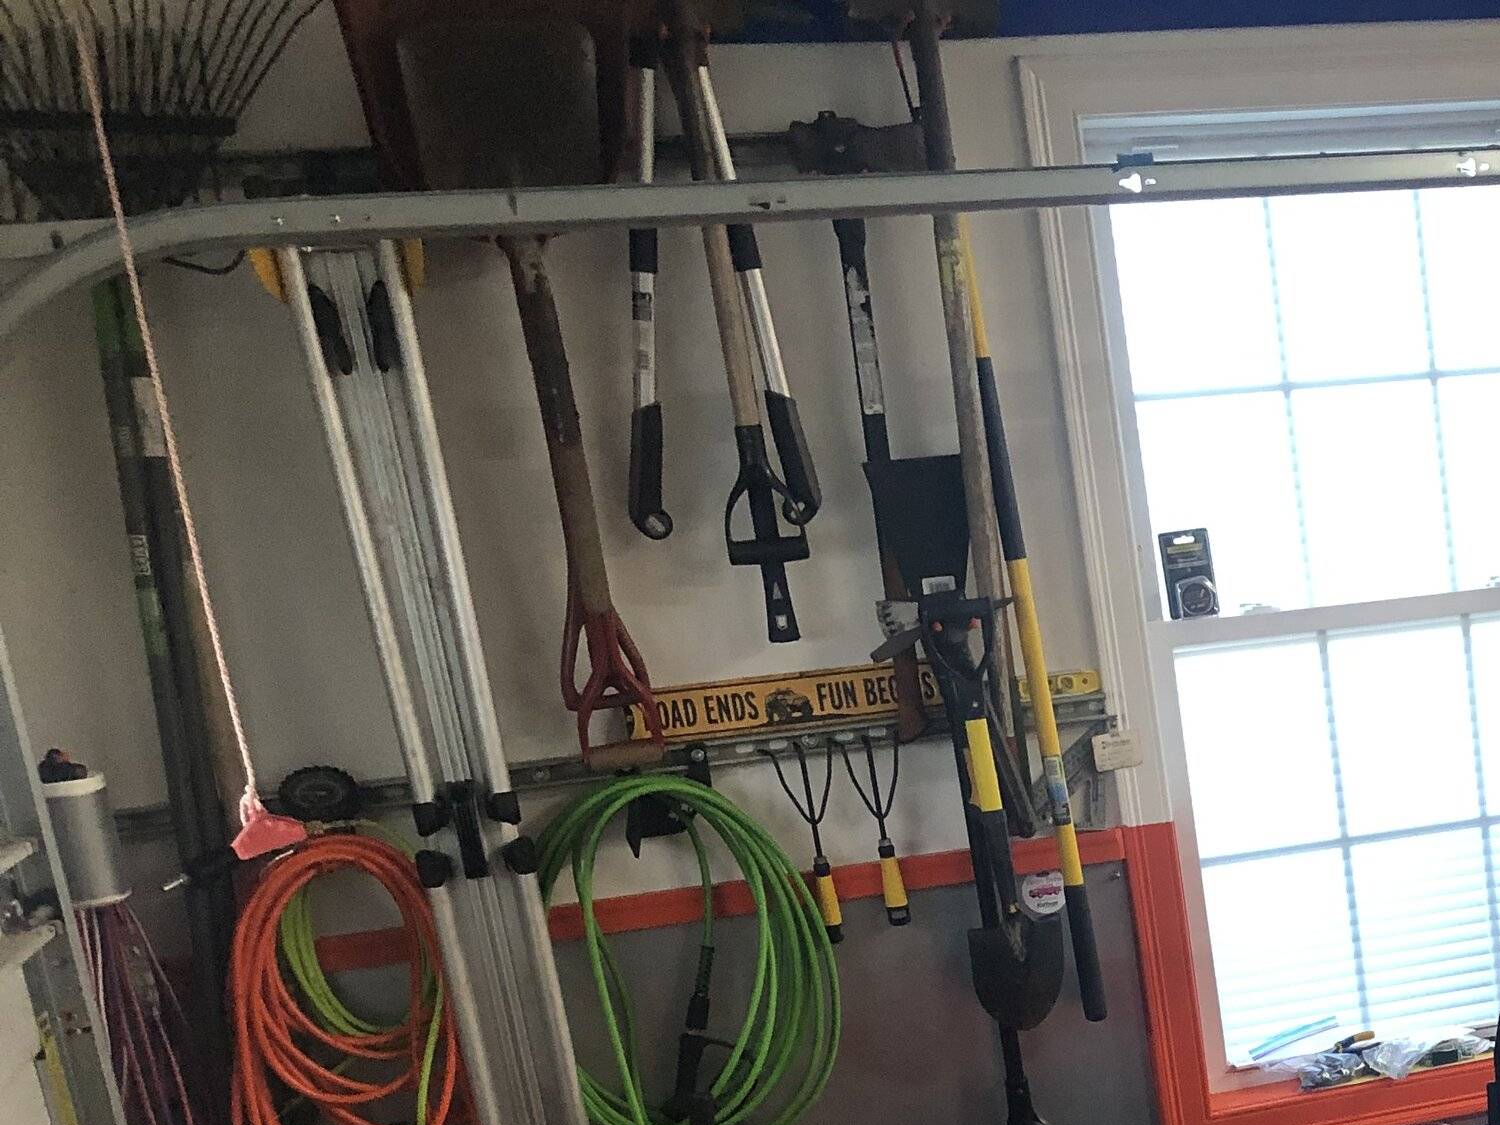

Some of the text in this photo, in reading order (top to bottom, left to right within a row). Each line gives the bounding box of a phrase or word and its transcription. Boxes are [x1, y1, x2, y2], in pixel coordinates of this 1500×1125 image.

[643, 671, 936, 733] OAD ENDS FUN BEGS
